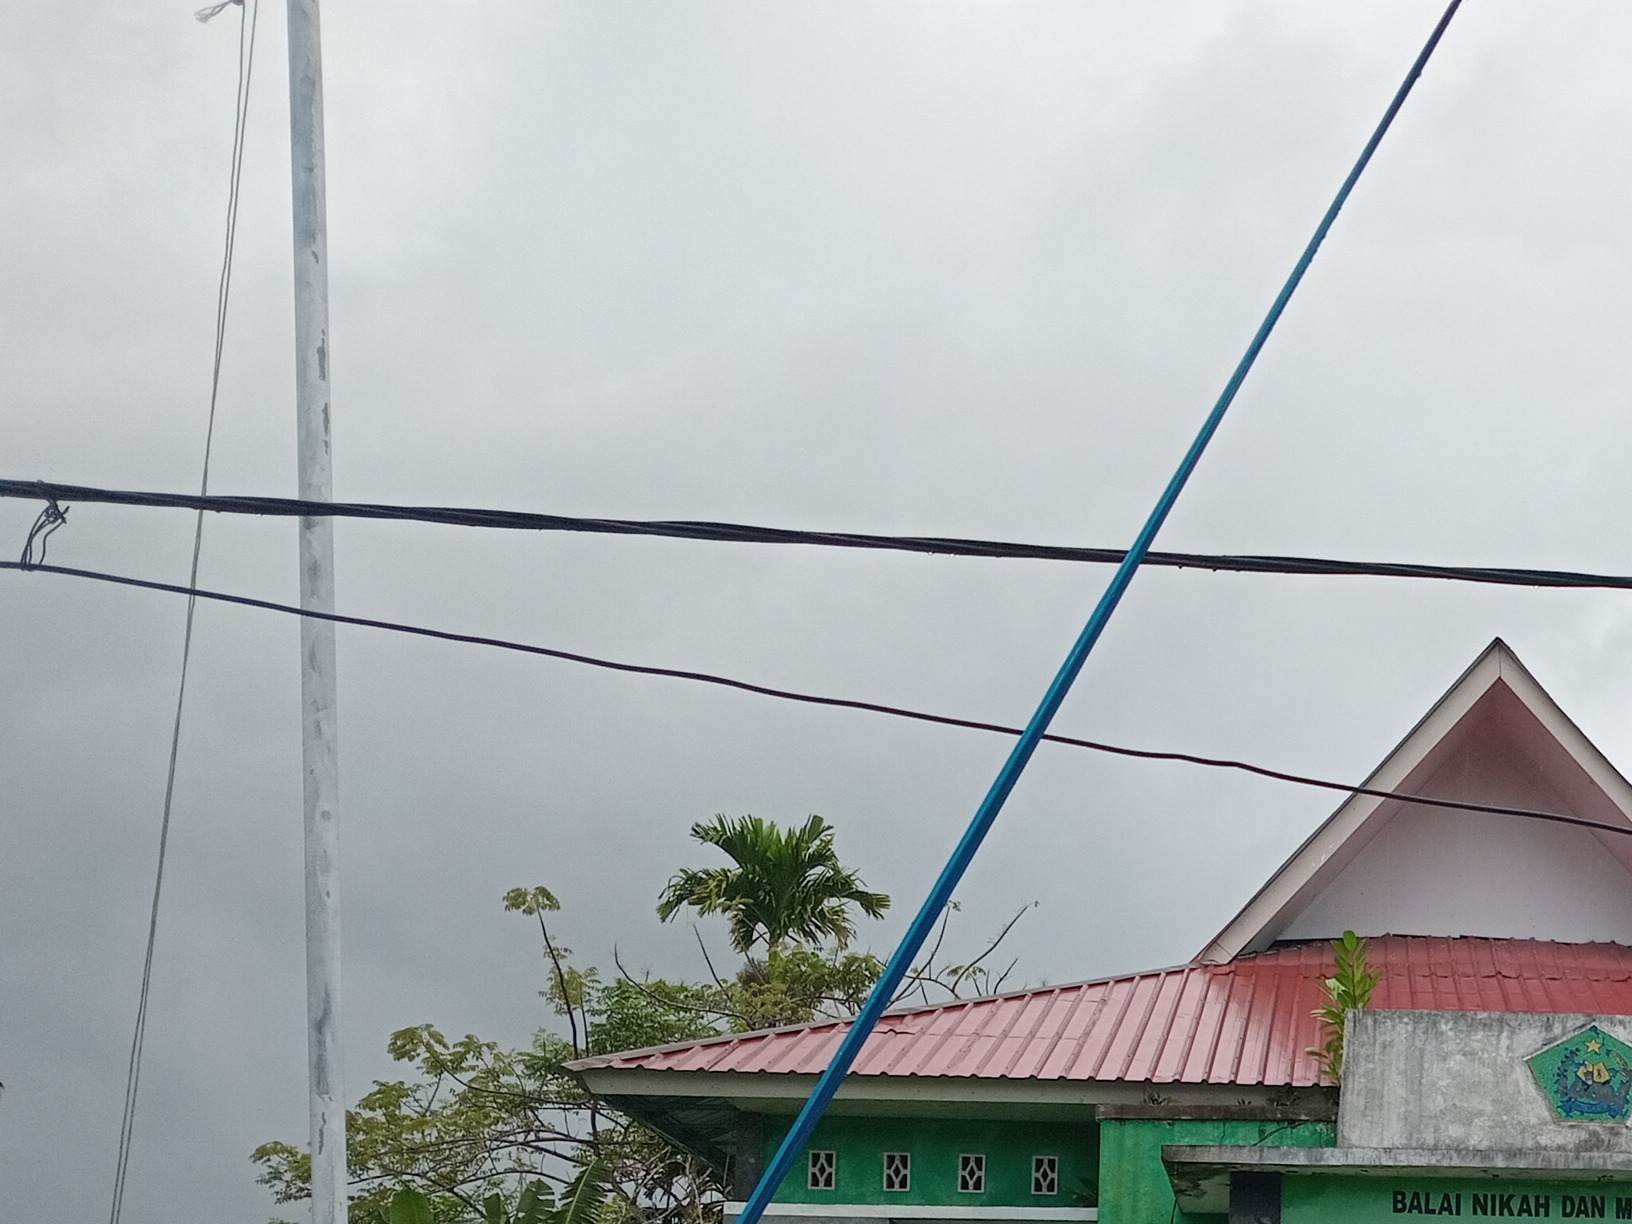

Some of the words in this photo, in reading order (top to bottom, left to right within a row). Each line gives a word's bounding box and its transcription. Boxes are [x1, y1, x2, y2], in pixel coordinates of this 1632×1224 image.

[1391, 1190, 1462, 1216] BALAI
[1472, 1193, 1550, 1218] NIKAH
[1561, 1195, 1605, 1219] DAN
